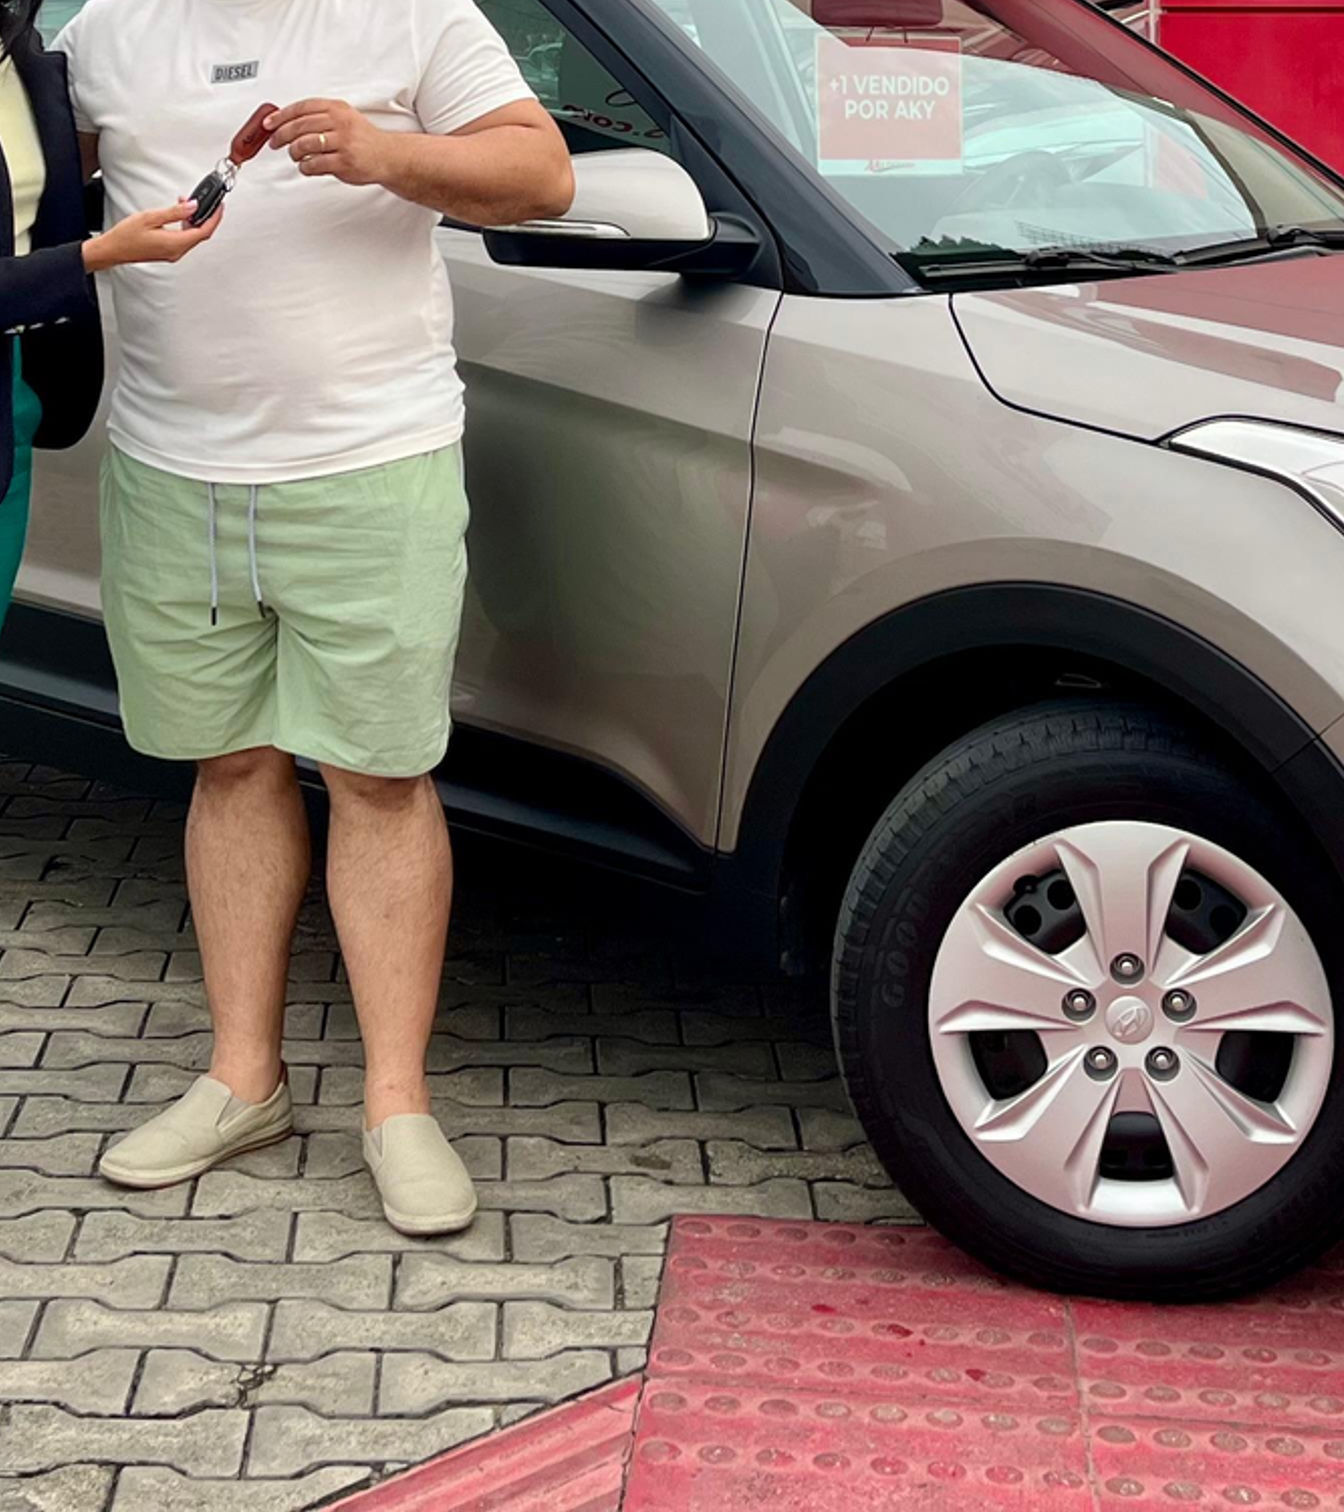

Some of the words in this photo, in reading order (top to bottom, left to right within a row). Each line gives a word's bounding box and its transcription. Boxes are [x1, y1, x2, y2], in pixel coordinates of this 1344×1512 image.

[214, 63, 253, 80] DIESEL
[830, 75, 847, 95] +1
[854, 75, 949, 95] VENDIDO
[845, 100, 888, 119] POR
[895, 100, 935, 119] AKY
